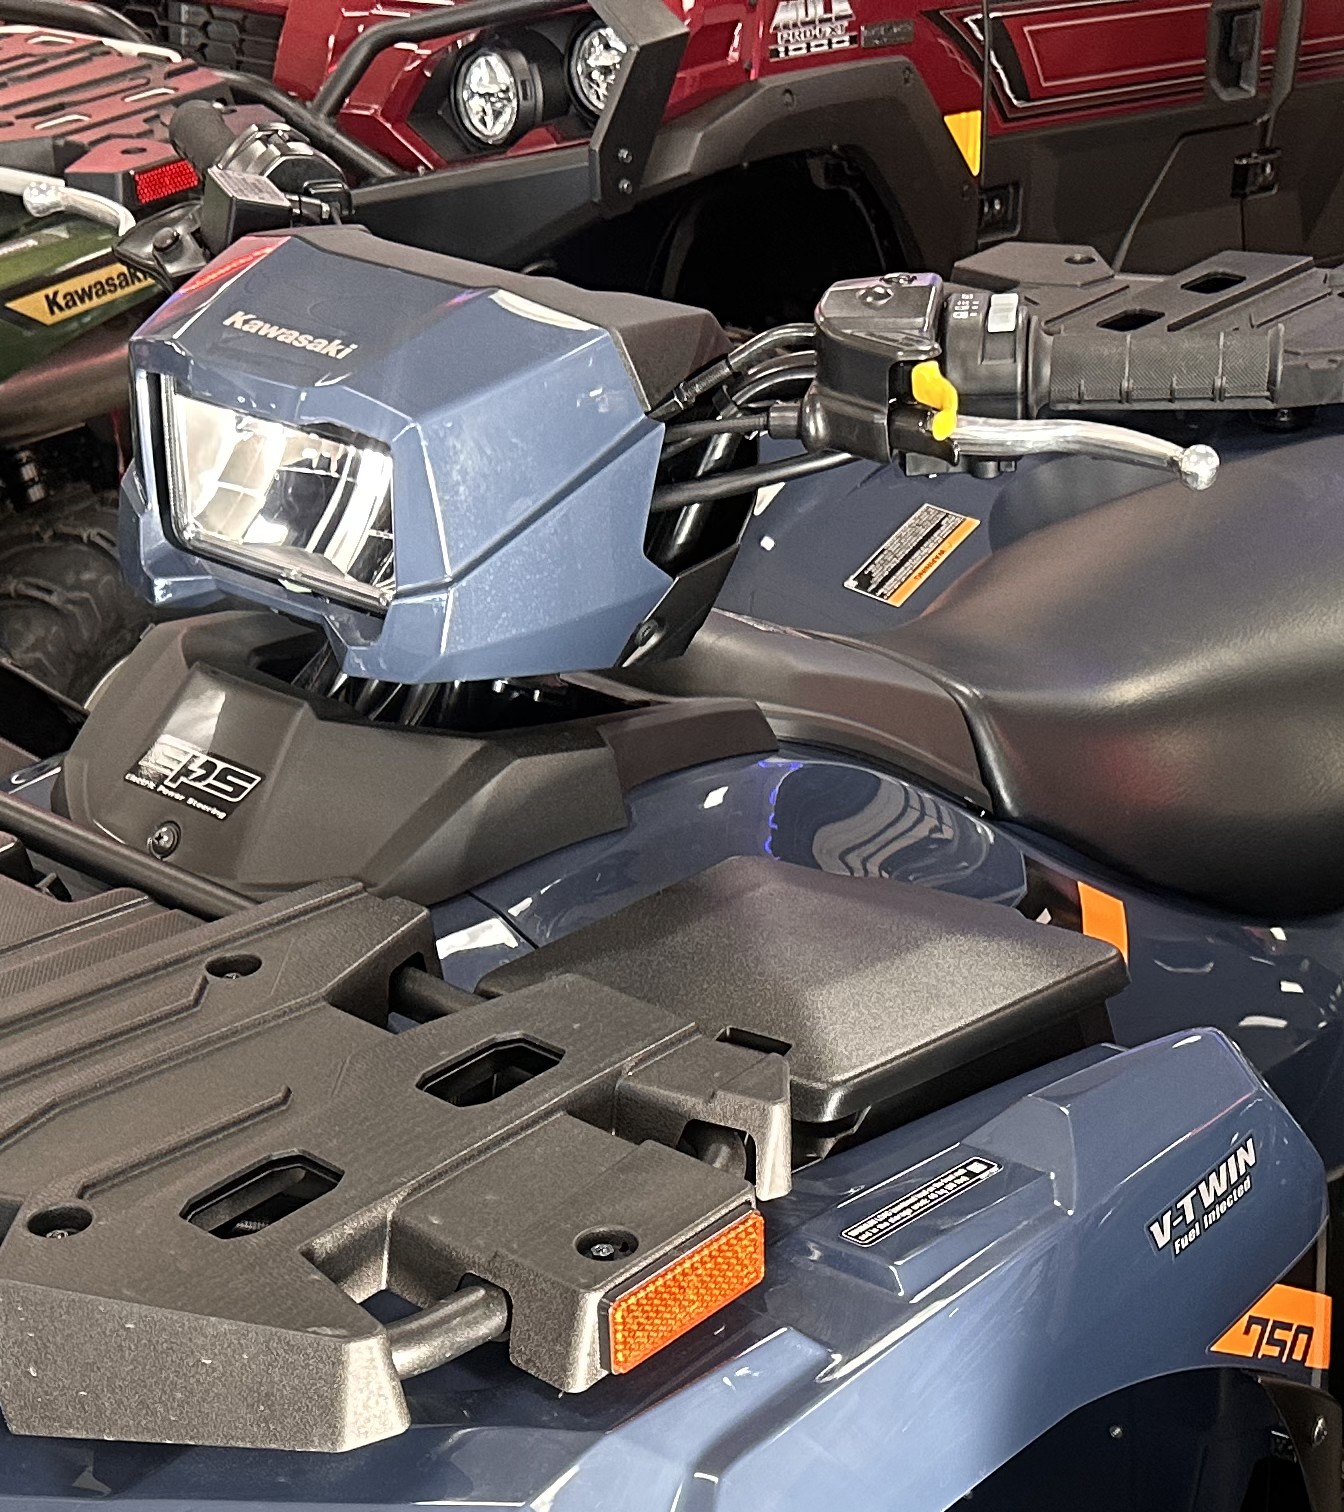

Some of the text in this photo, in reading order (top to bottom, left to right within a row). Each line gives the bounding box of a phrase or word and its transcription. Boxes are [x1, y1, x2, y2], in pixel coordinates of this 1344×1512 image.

[222, 310, 359, 360] Kawasaki
[138, 734, 262, 803] EPS
[156, 785, 186, 801] Power
[186, 797, 227, 820] Steering
[1149, 1137, 1256, 1249] V-TWIN
[1174, 1221, 1201, 1255] Fuel
[1243, 1314, 1315, 1366] 750
